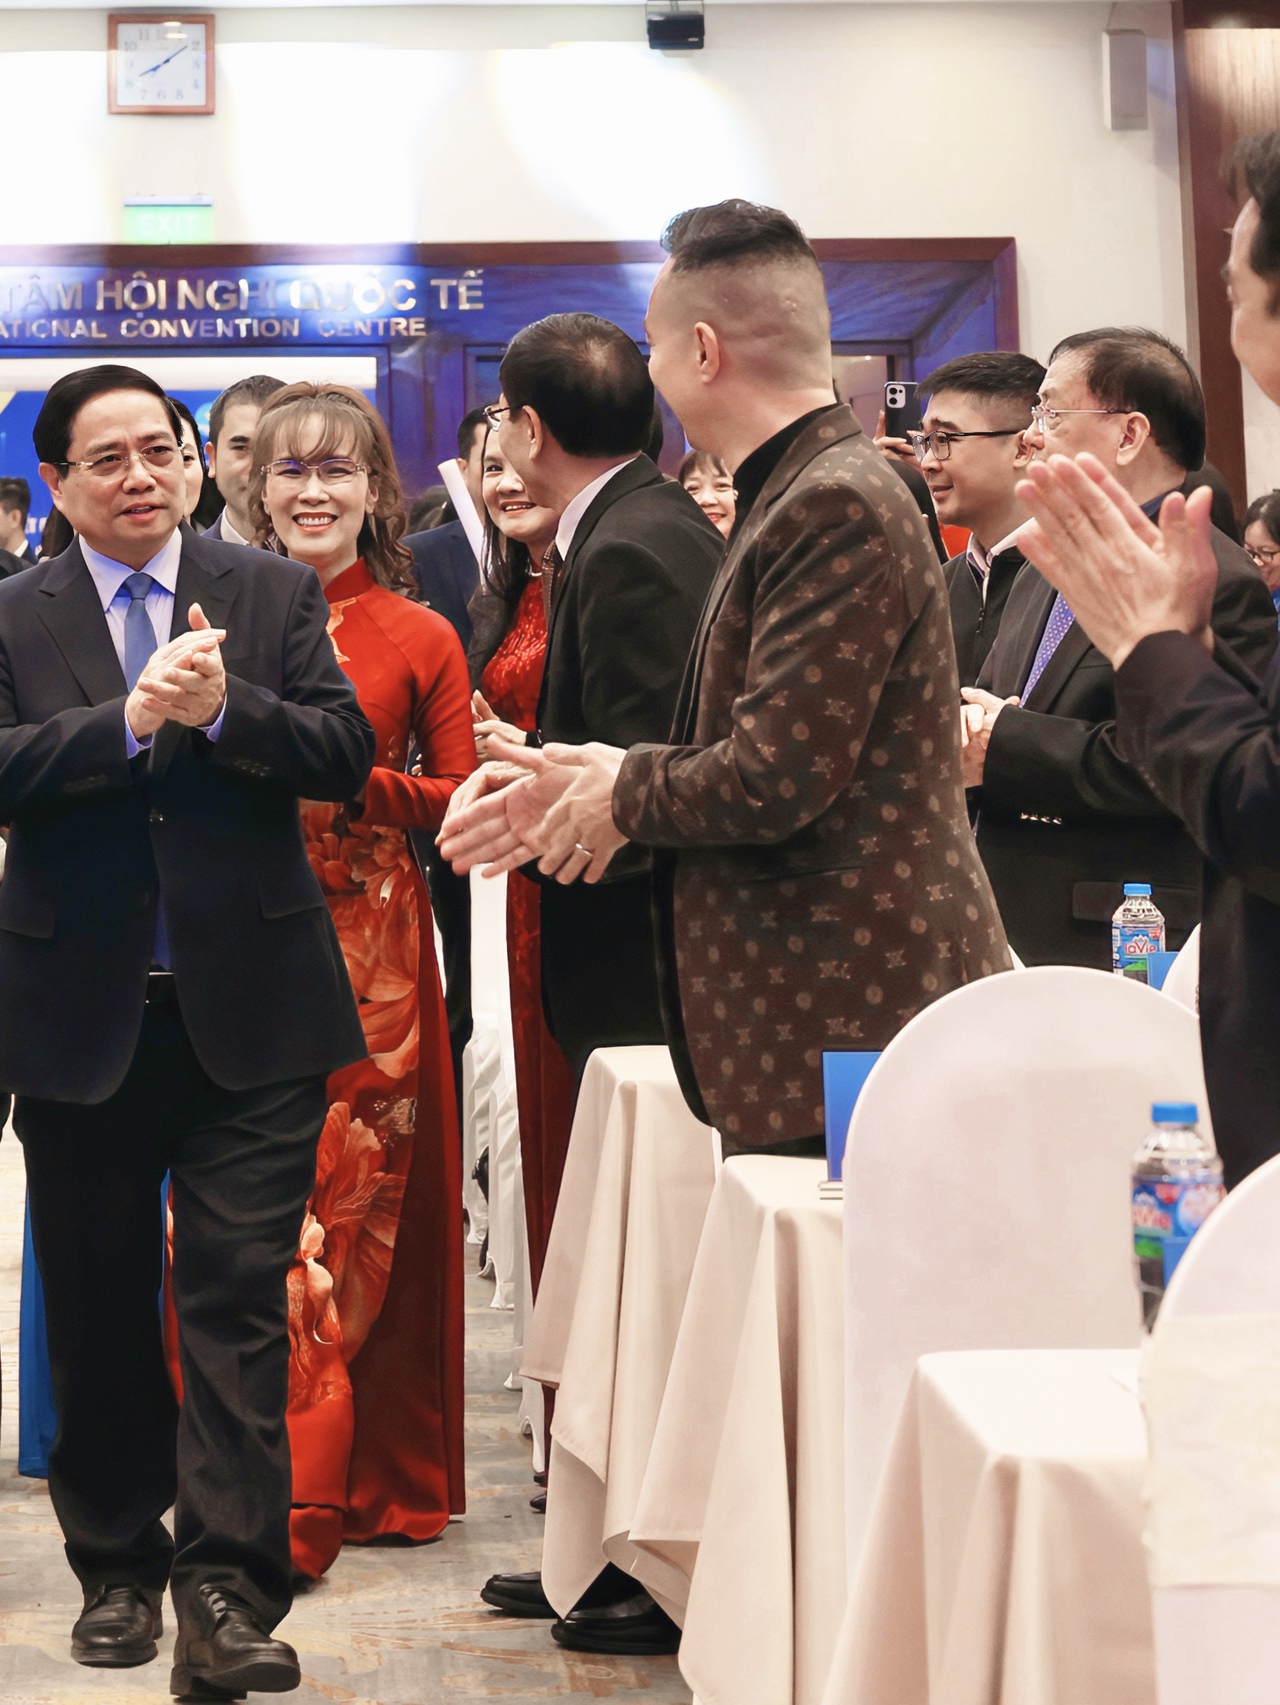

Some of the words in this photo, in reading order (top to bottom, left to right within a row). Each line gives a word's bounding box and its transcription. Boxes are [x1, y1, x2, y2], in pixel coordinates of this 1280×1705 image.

[138, 213, 199, 236] EXIT
[95, 270, 167, 318] HỘI
[177, 278, 278, 317] NGHỊ
[429, 268, 485, 311] TẾ
[120, 318, 300, 338] CONVENTION
[318, 316, 427, 338] CENTRE
